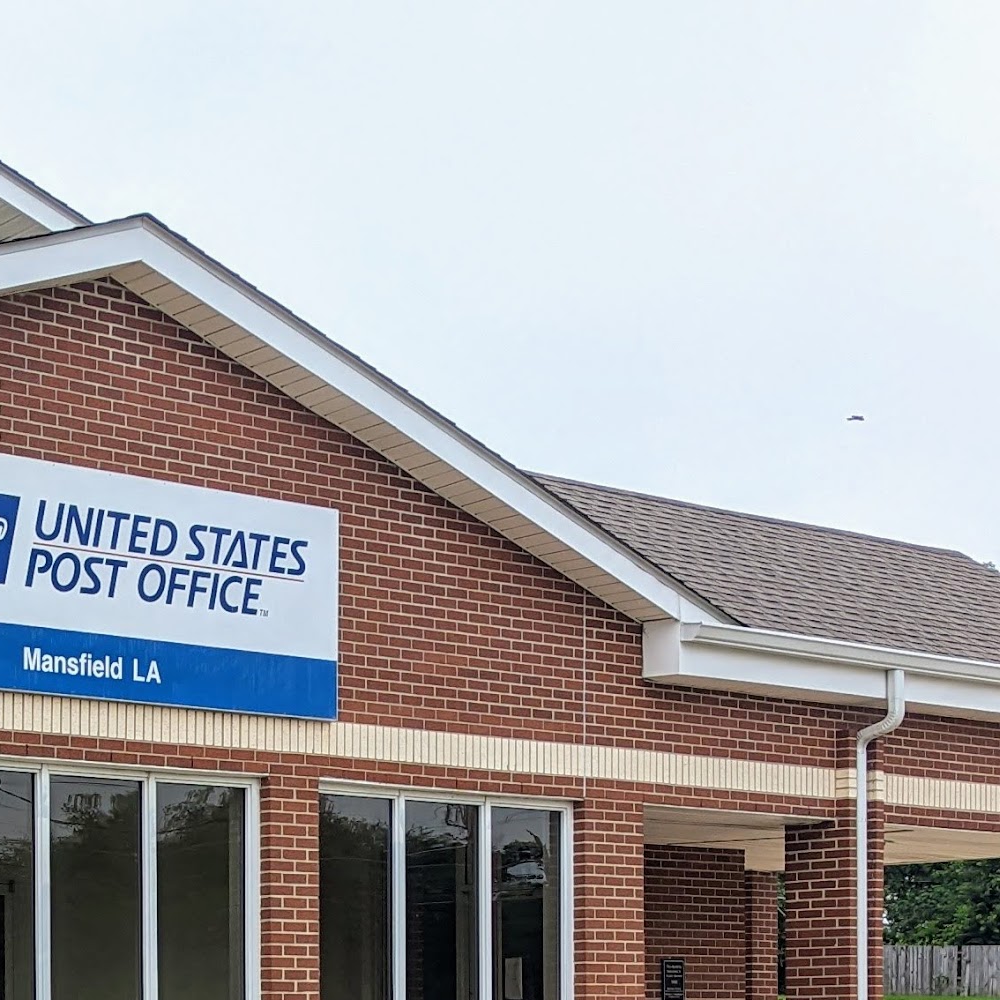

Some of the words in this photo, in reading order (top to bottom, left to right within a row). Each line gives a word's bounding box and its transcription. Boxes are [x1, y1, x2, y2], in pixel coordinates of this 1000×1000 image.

[35, 499, 178, 556] UNITED
[185, 524, 308, 576] STATES
[25, 548, 128, 598] POST
[138, 563, 262, 616] OFFICE
[23, 646, 123, 680] Mansfield
[133, 658, 162, 684] LA
